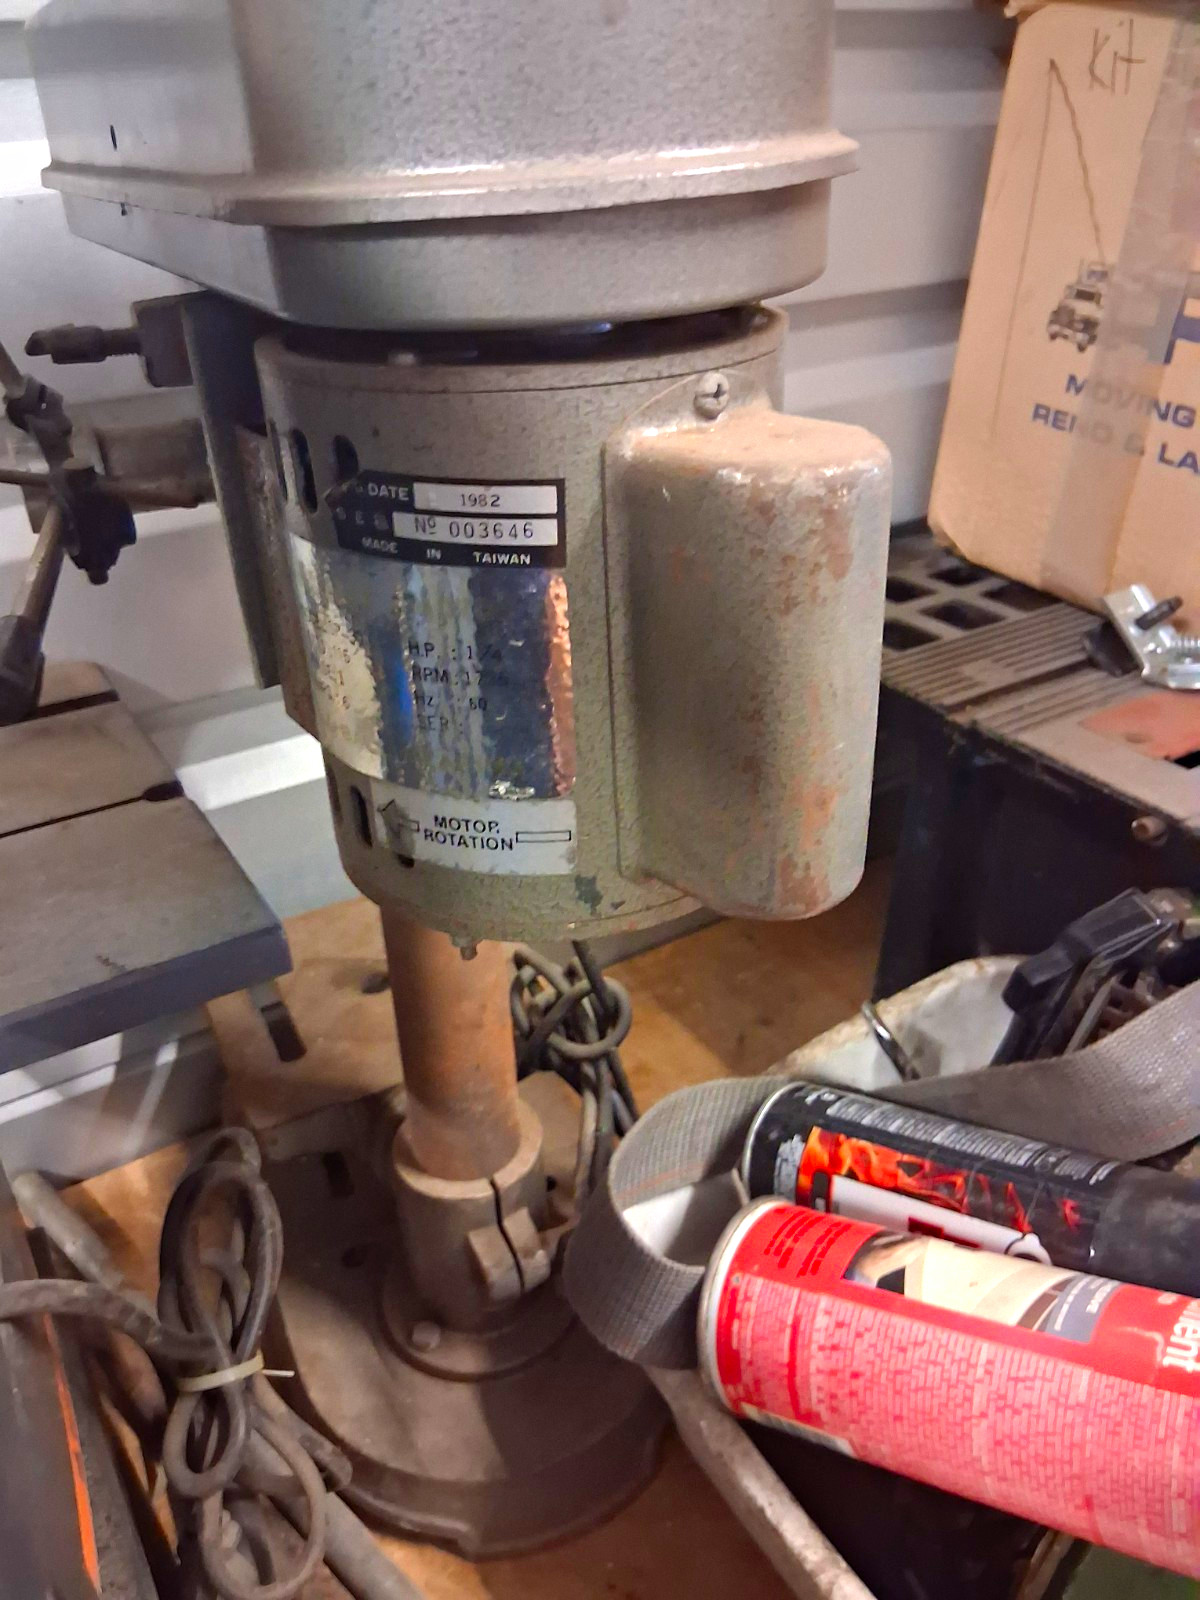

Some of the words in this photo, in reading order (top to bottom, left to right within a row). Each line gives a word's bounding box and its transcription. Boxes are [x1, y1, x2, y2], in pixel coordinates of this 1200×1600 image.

[367, 482, 409, 501] DATE
[460, 493, 501, 508] 1982
[449, 520, 534, 540] 003646
[362, 536, 399, 554] MADE
[426, 548, 442, 560] IN
[472, 551, 531, 565] TAIWAN
[424, 828, 514, 851] ROTATION
